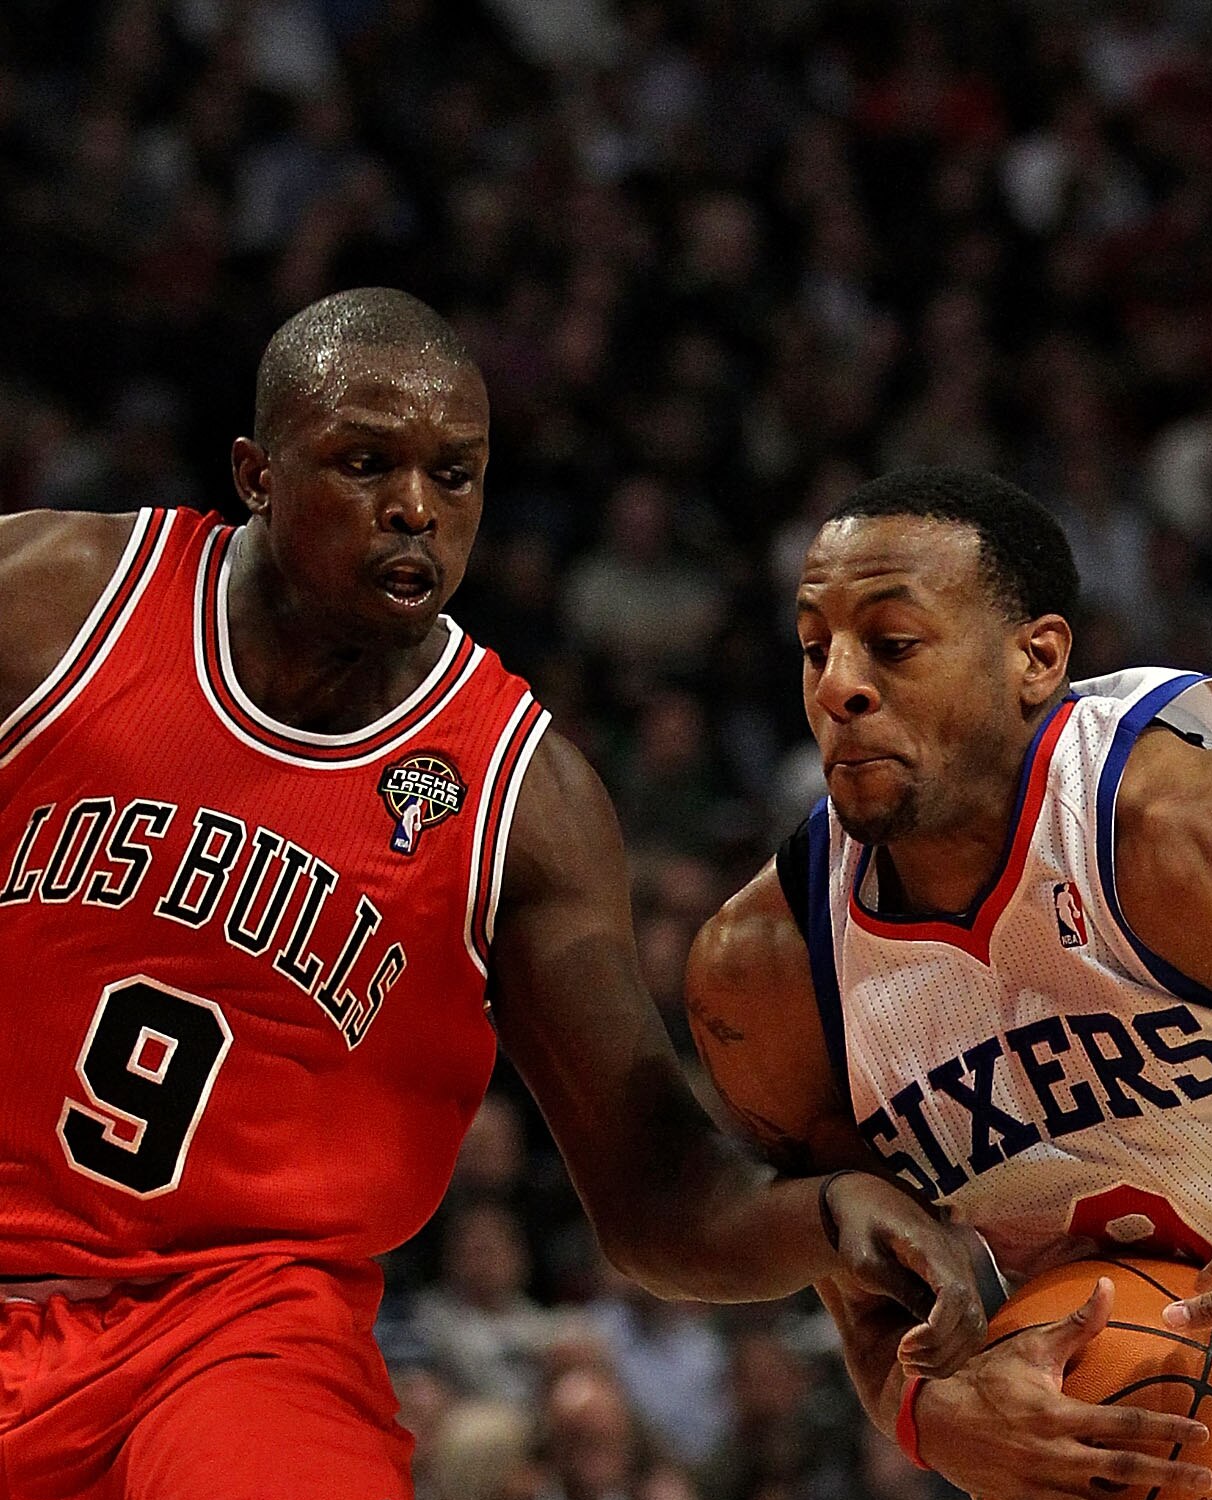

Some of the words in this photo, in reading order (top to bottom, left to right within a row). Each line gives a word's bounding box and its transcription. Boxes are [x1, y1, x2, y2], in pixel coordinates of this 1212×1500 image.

[386, 778, 458, 807] LATINA
[392, 769, 460, 796] NOCHE
[0, 797, 178, 909] LOS
[153, 807, 407, 1051] BULLS
[1061, 934, 1079, 945] NBA
[56, 974, 234, 1200] 9
